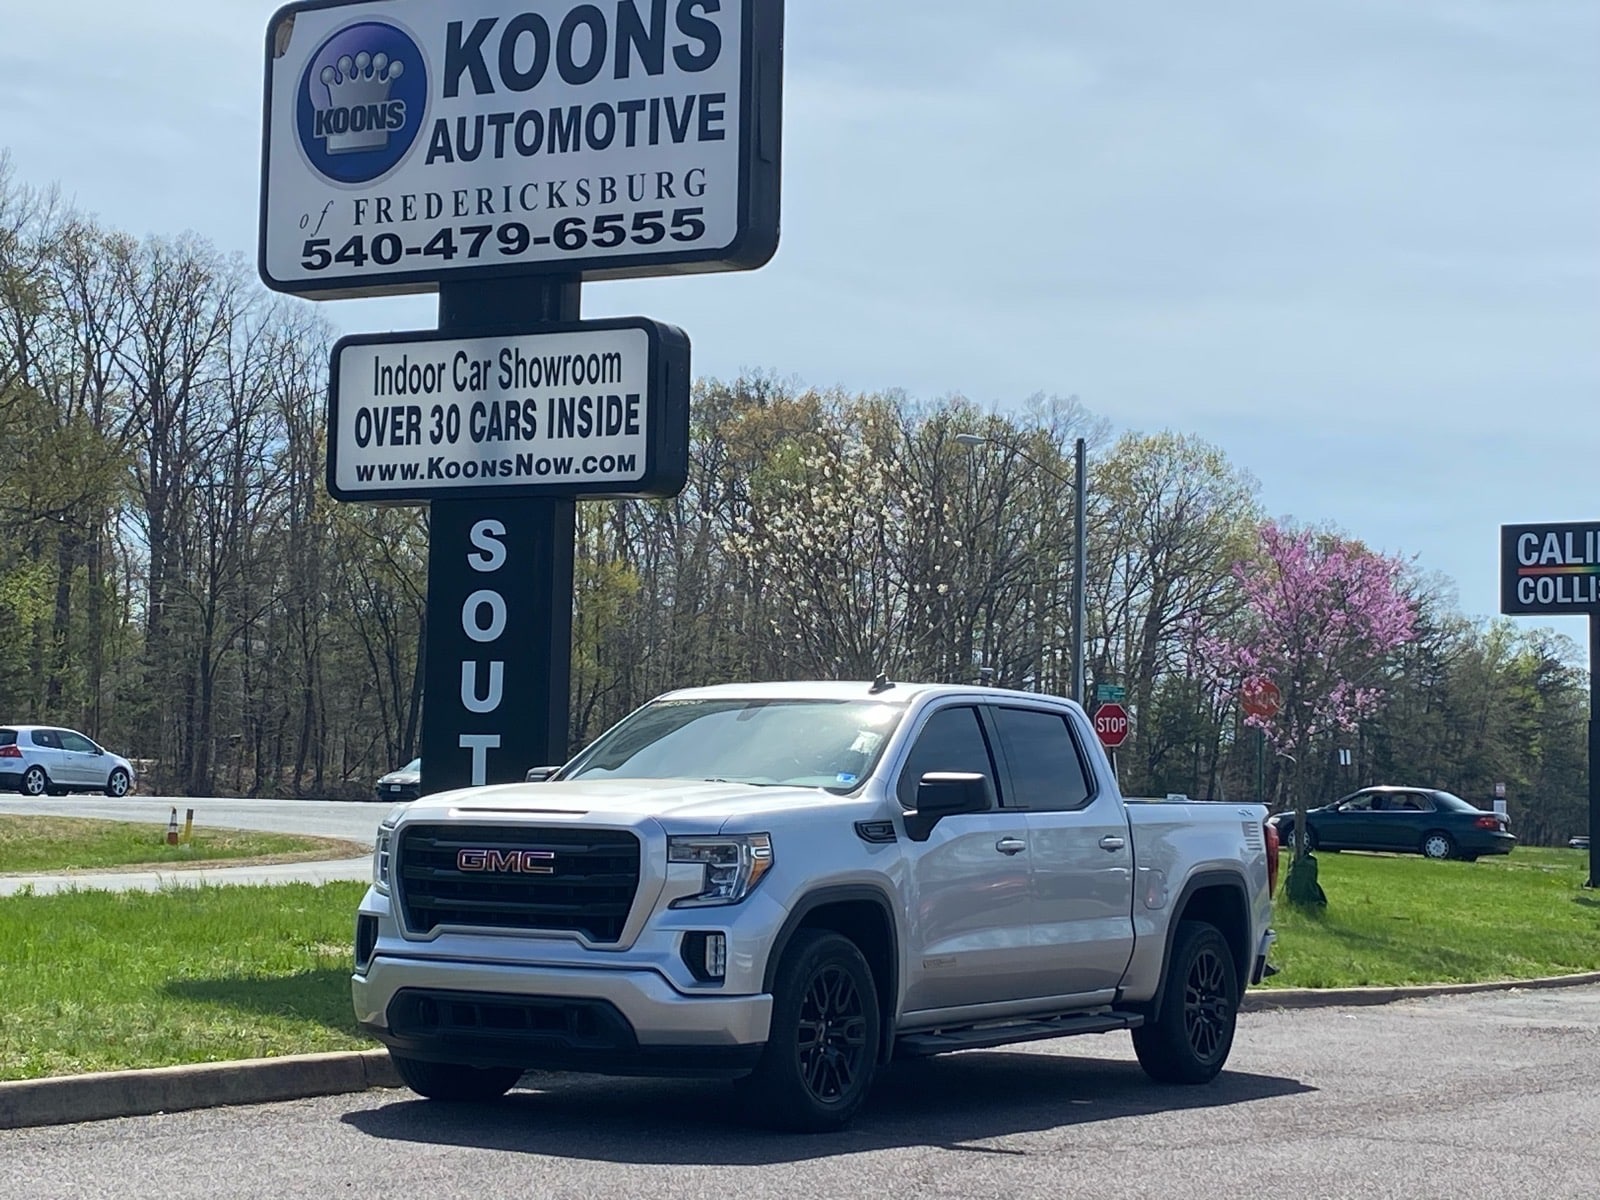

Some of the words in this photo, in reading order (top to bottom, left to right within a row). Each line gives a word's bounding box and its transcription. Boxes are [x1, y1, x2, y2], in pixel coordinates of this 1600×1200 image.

[442, 0, 723, 98] KOONS
[313, 100, 406, 137] KOONS
[425, 93, 726, 165] AUTOMOTIVE
[299, 200, 334, 237] of
[353, 168, 707, 226] FREDERICKSBURG
[301, 208, 706, 270] 540-479-6555
[374, 354, 446, 396] Indoor
[452, 350, 492, 392] Car
[499, 347, 622, 390] Showroom
[354, 405, 422, 448] OVER
[429, 403, 461, 445] 30
[469, 398, 537, 443] CARS
[547, 393, 640, 440] INSIDE
[1517, 576, 1600, 604] COLLI
[1097, 717, 1126, 733] STOP
[456, 849, 554, 874] GMC
